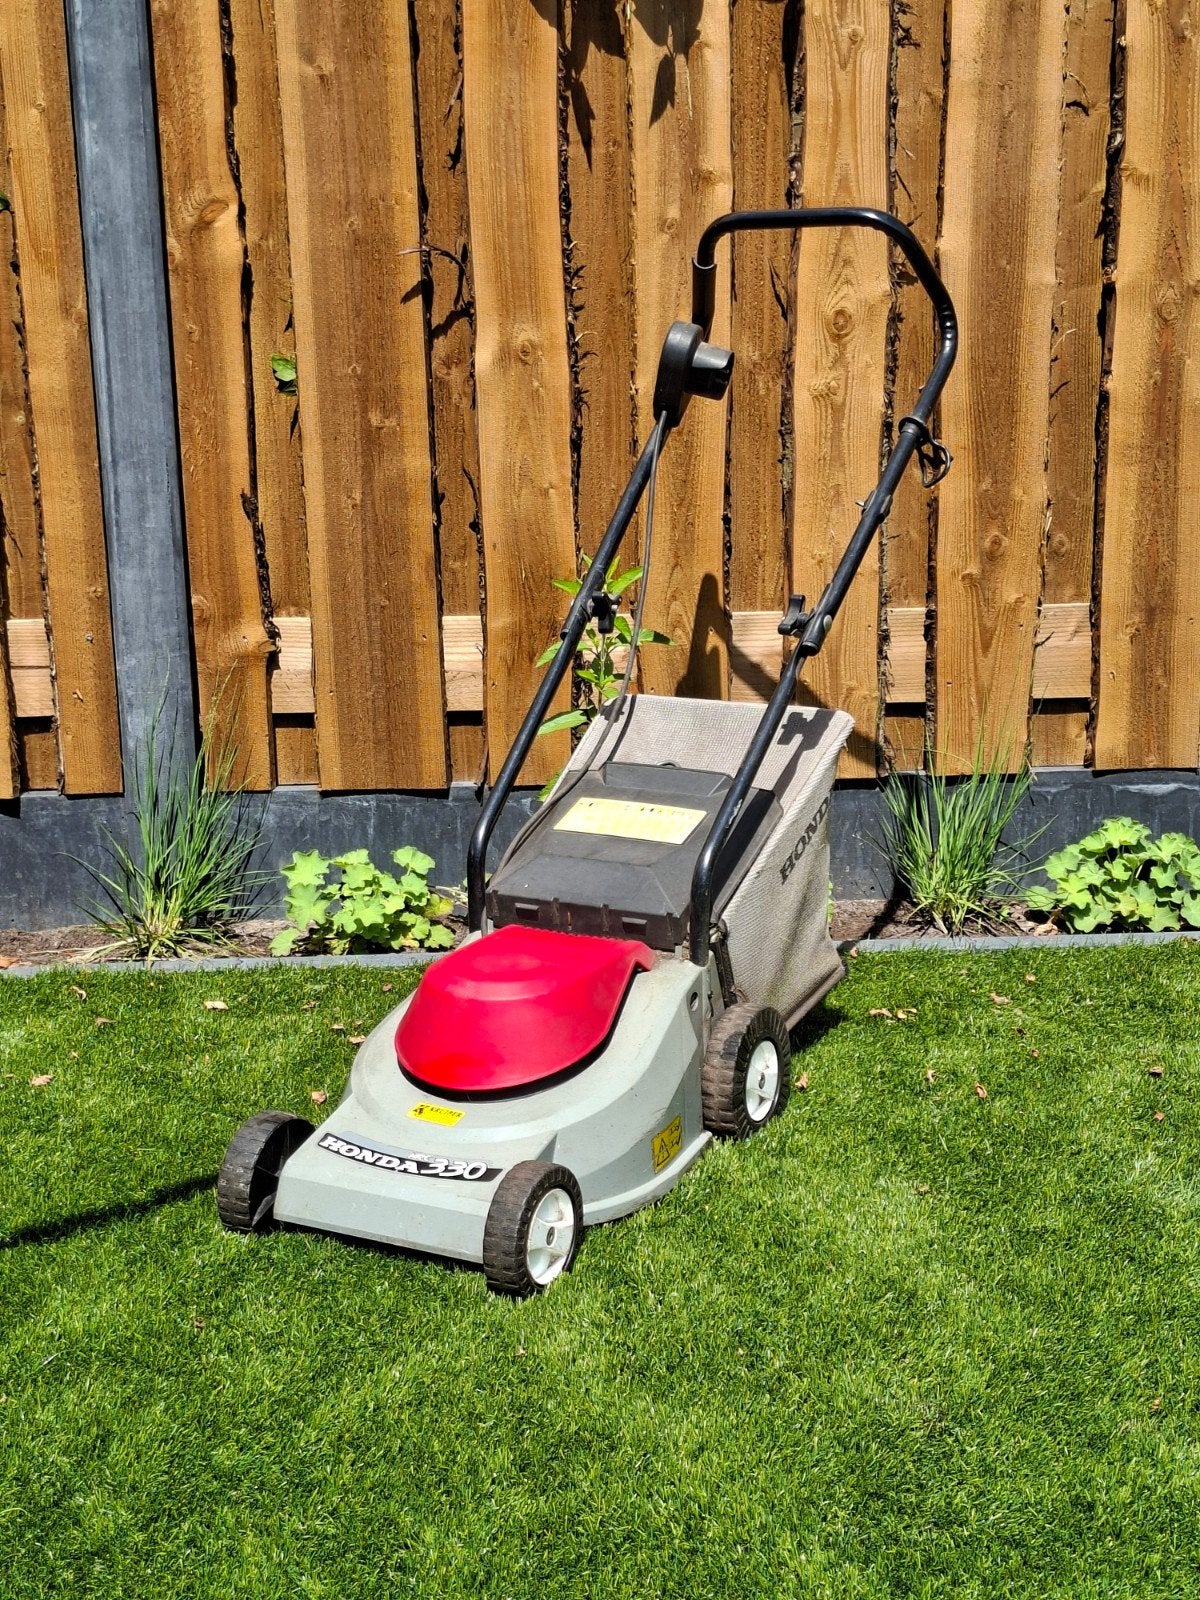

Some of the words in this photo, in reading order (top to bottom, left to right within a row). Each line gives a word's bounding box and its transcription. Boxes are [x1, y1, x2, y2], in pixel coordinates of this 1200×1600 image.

[780, 796, 829, 886] HOND
[320, 1136, 419, 1174] HONDA
[420, 1158, 488, 1180] 330
